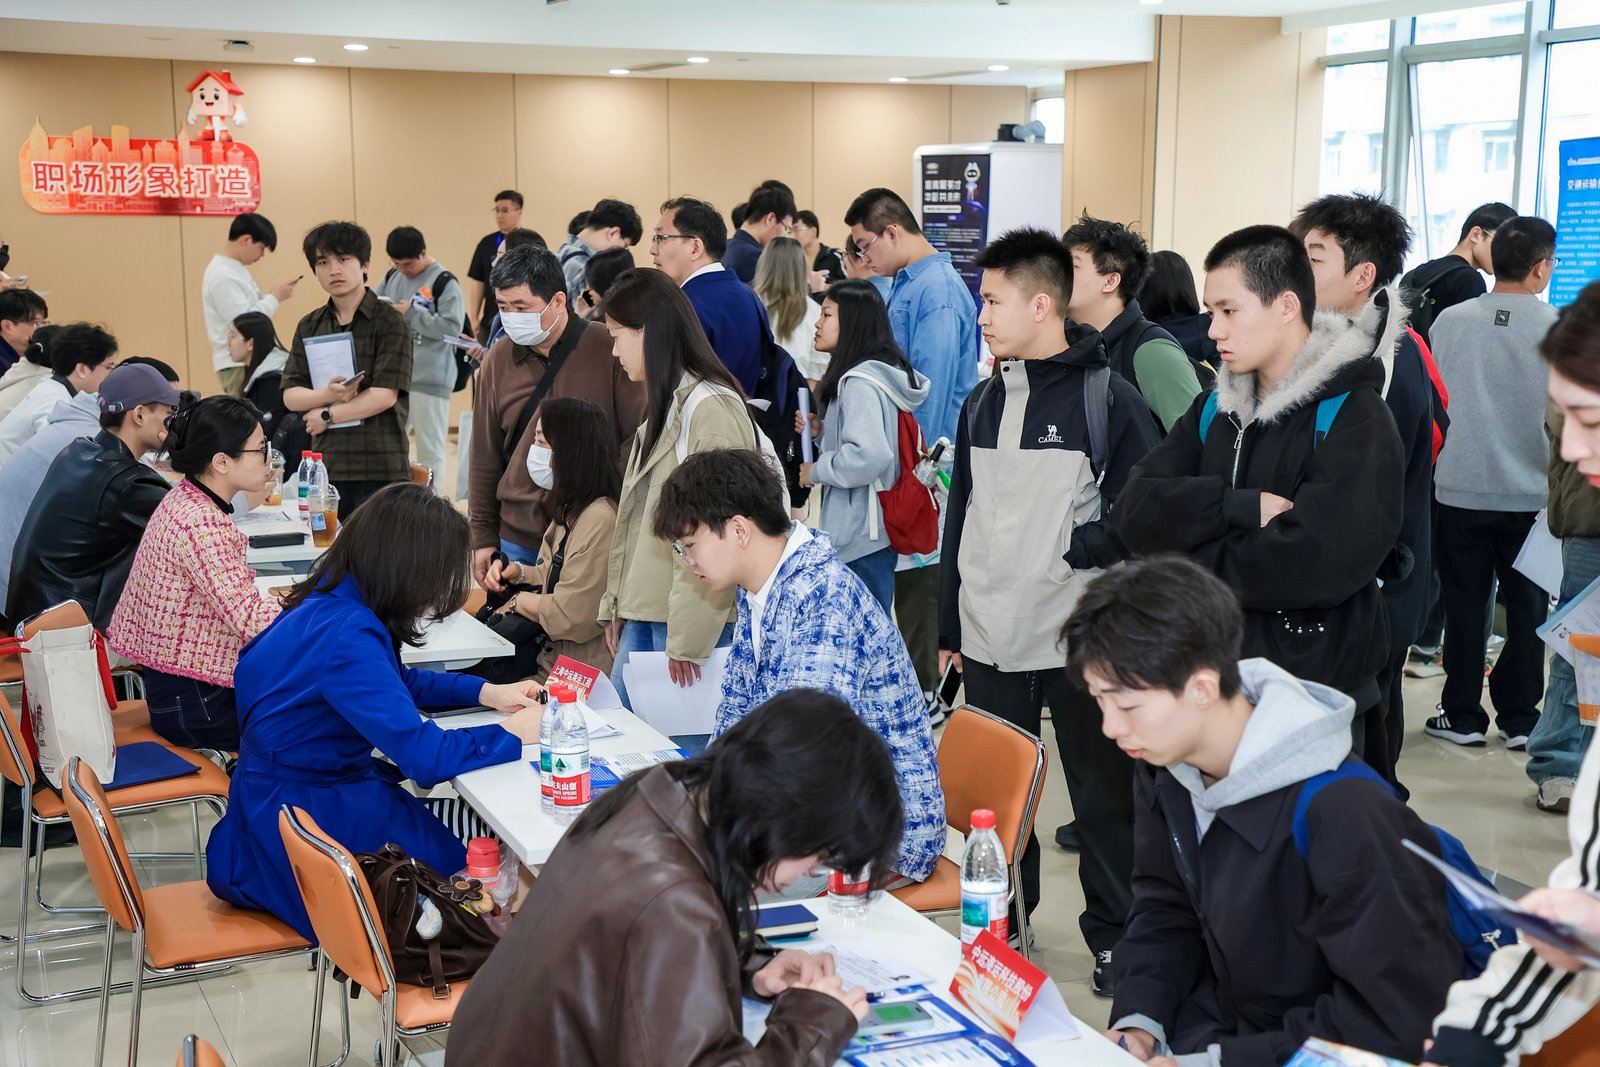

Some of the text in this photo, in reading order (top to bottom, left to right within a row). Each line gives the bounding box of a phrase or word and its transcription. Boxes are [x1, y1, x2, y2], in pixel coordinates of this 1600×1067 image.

[32, 161, 251, 198] 职场形象打造
[972, 945, 1033, 1002] 中远海运科技股份
